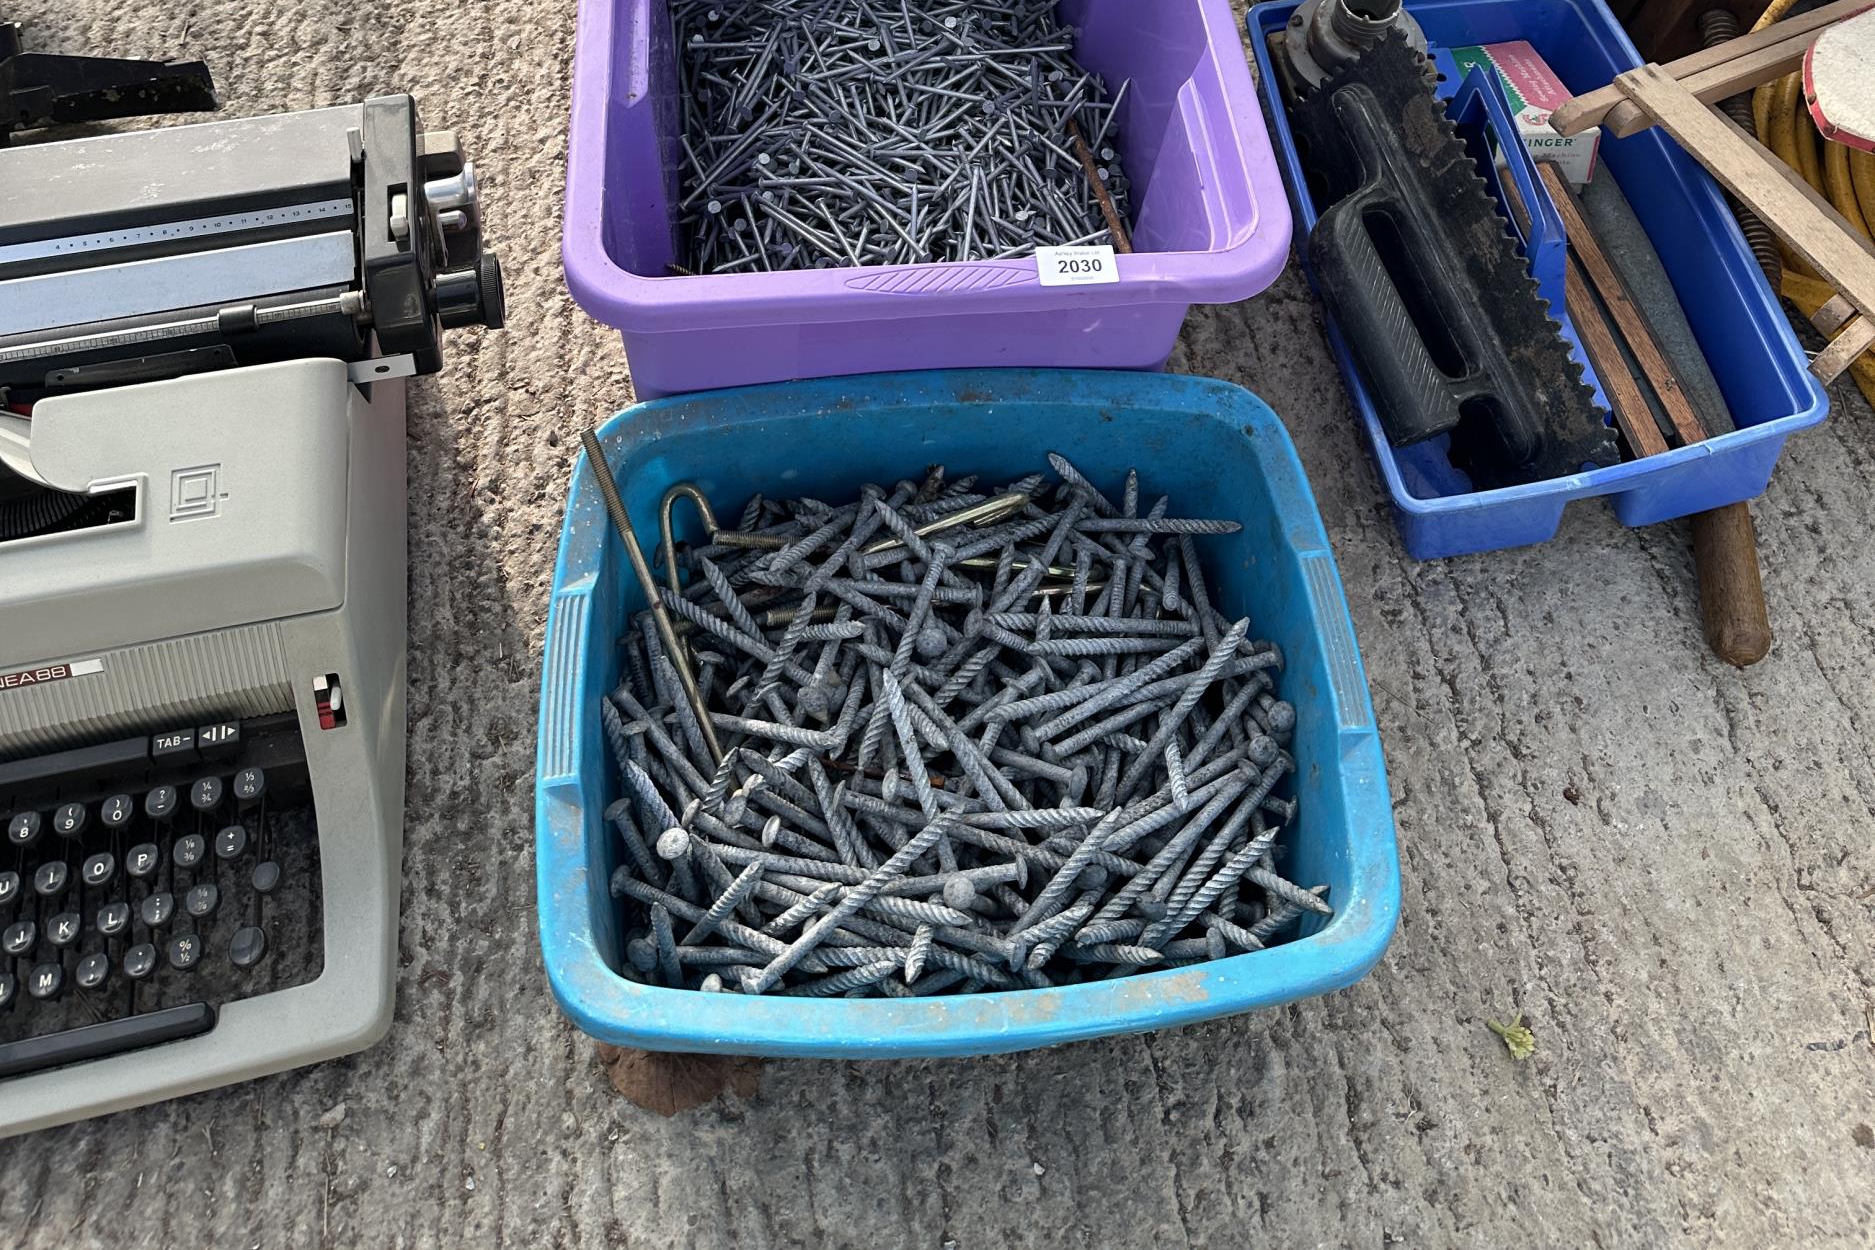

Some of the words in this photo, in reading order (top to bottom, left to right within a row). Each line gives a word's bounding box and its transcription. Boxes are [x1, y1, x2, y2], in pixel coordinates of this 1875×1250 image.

[1523, 138, 1573, 147] INGER
[1058, 259, 1102, 273] 2030
[65, 818, 74, 829] 9
[20, 827, 29, 838] 8
[138, 854, 148, 866] P
[94, 863, 104, 875] O
[0, 881, 9, 895] U
[108, 913, 118, 925] L
[58, 921, 70, 935] K
[15, 931, 25, 944] J
[179, 939, 192, 952] %
[39, 973, 52, 987] M
